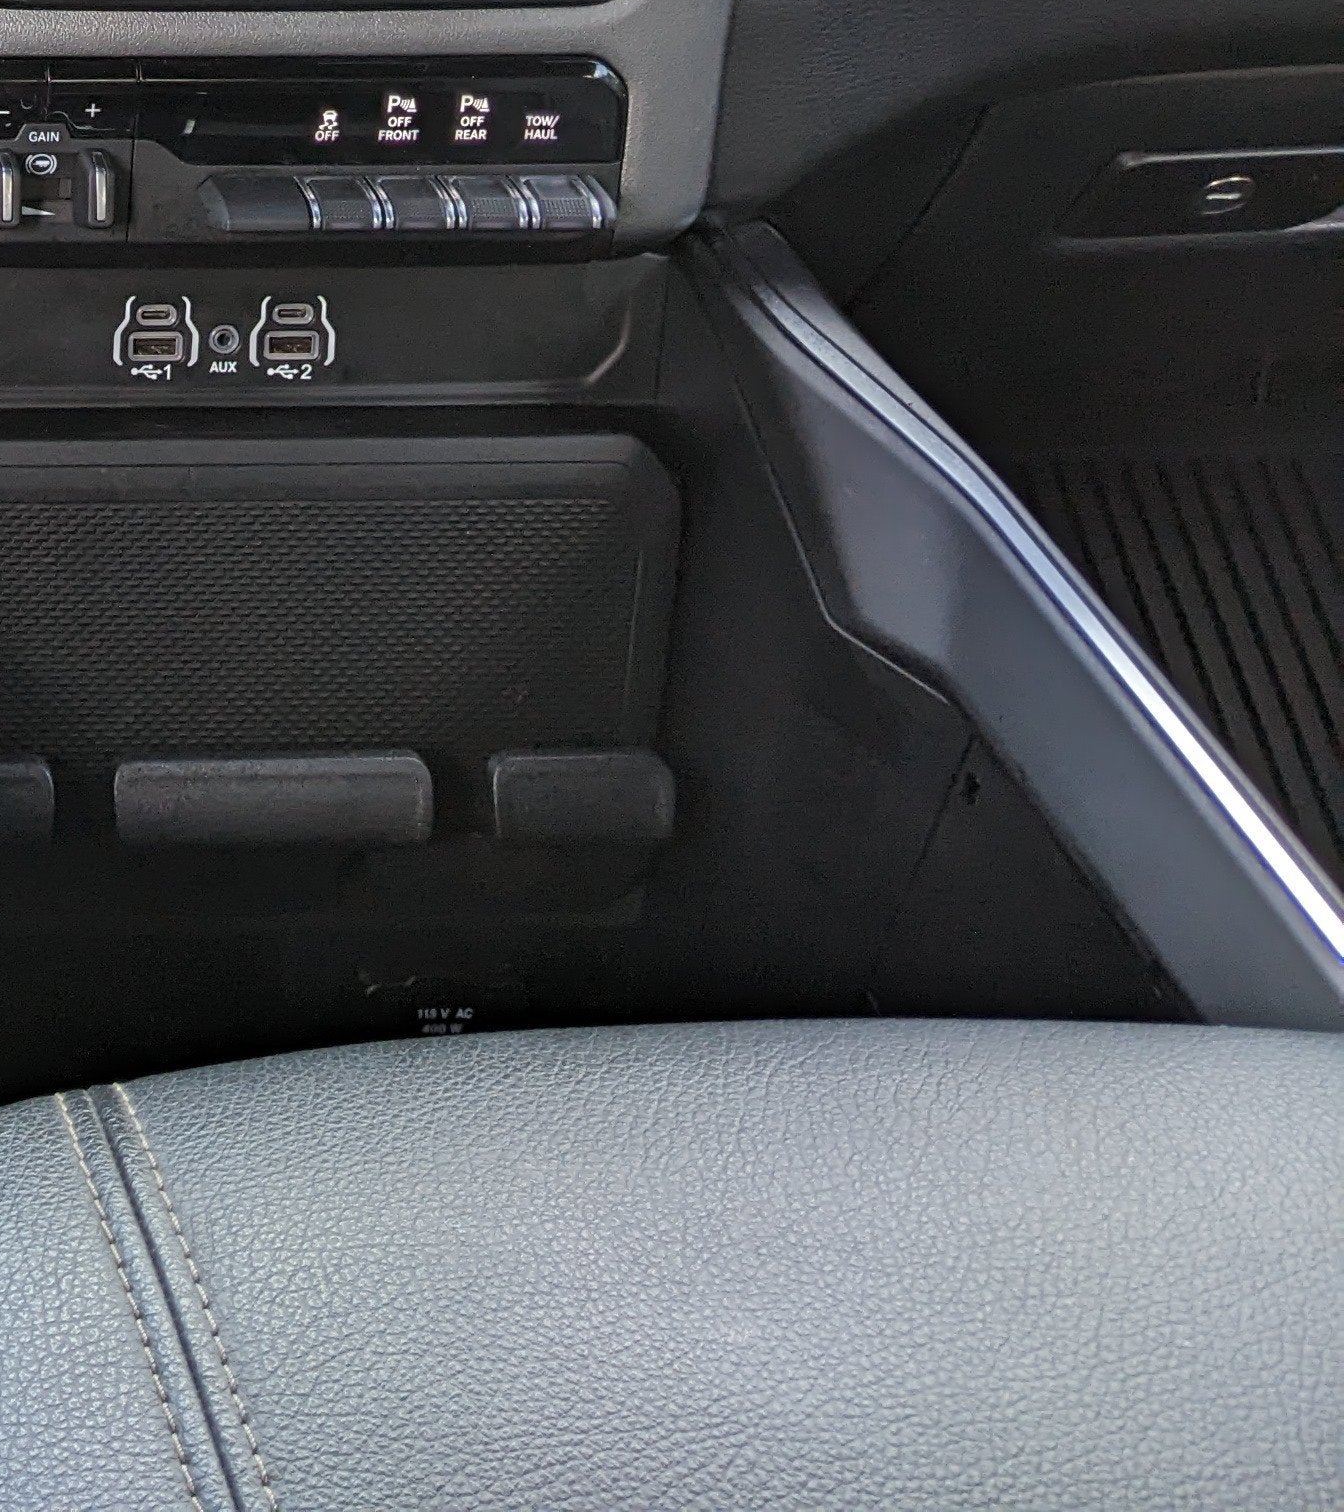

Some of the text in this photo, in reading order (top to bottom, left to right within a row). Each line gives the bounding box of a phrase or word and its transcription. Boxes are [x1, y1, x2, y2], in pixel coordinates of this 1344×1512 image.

[387, 116, 412, 128] OFF
[460, 116, 484, 127] OFF
[526, 115, 560, 127] TOW/
[28, 131, 60, 143] GAIN
[314, 130, 340, 141] OFF
[377, 129, 419, 141] FRONT
[455, 129, 487, 140] REAR
[524, 129, 558, 140] HAUL
[163, 364, 172, 380] 1
[209, 361, 237, 373] AUX
[300, 363, 312, 380] 2
[455, 1008, 473, 1019] AC
